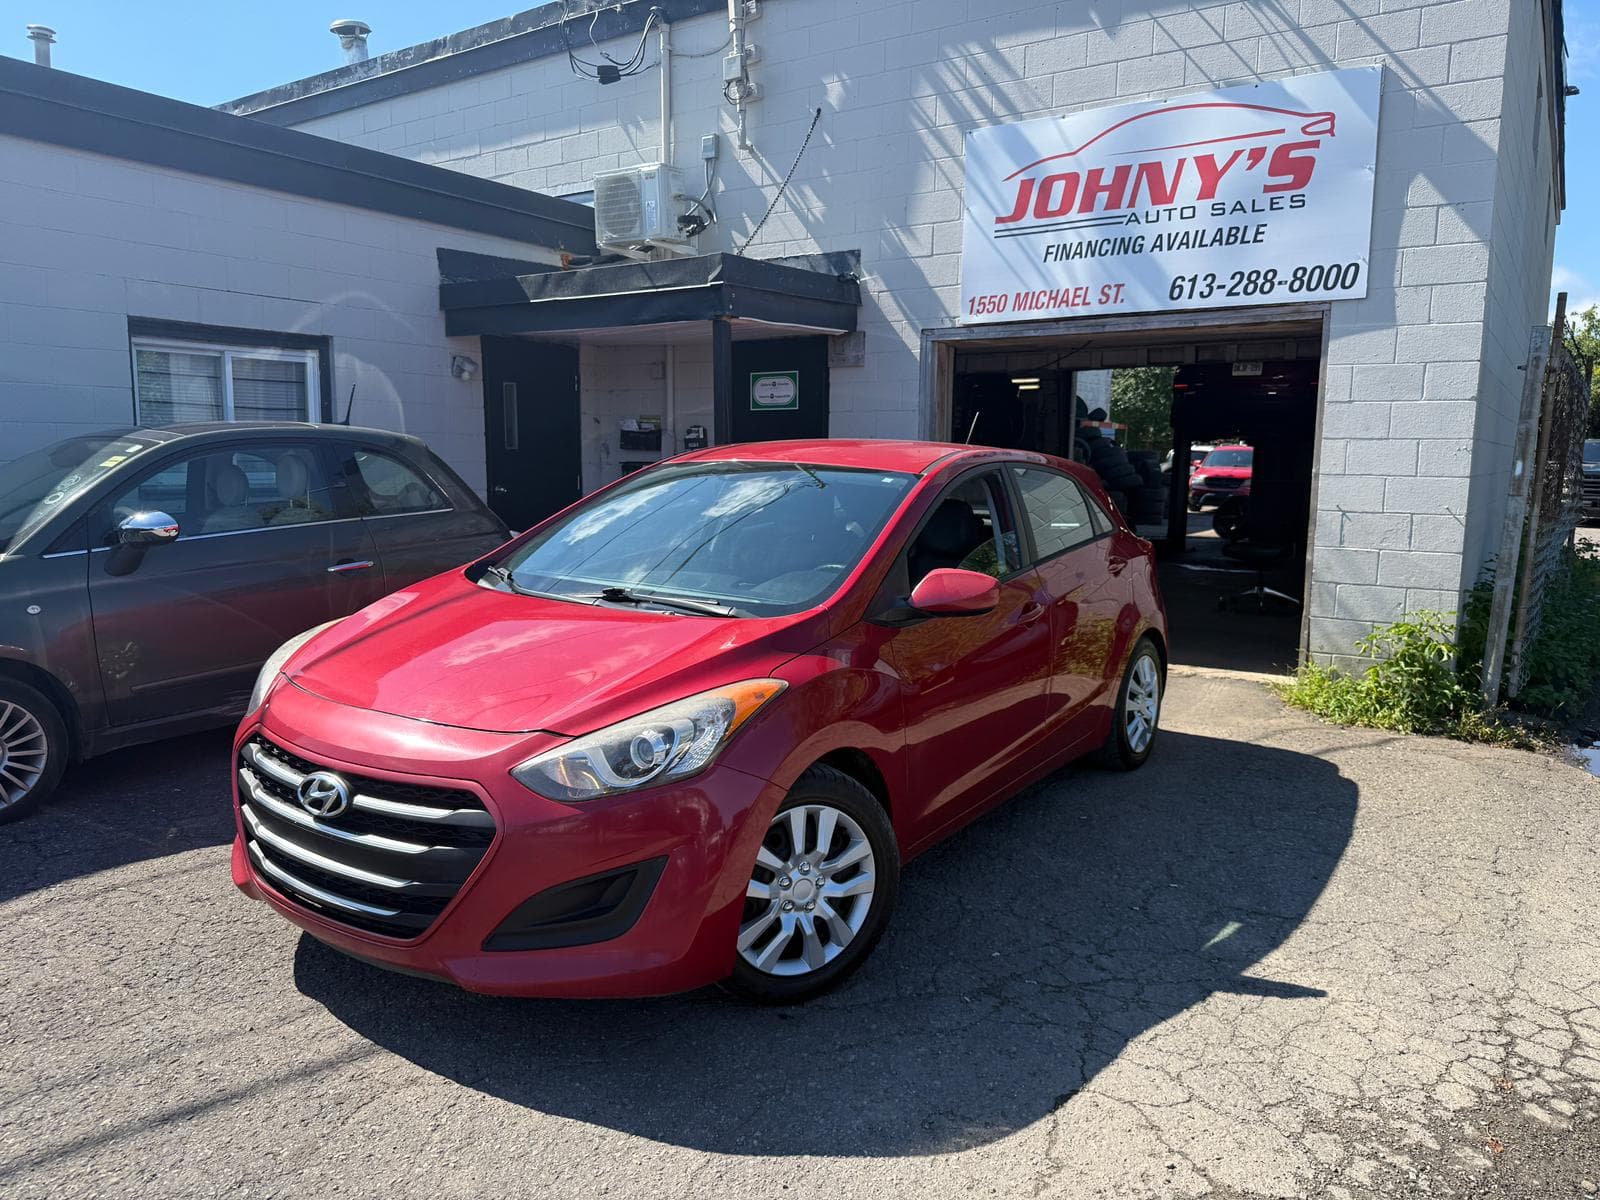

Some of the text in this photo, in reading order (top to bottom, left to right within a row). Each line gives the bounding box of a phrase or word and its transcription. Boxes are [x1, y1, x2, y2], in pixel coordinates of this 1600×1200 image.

[994, 139, 1321, 225] JOHNY'S
[1125, 193, 1306, 226] AUTO SALES
[1043, 223, 1268, 263] FINANCING AVAILABLE
[968, 283, 1126, 315] 1550 MICHAEL ST.
[1168, 262, 1361, 301] 613-288-8000
